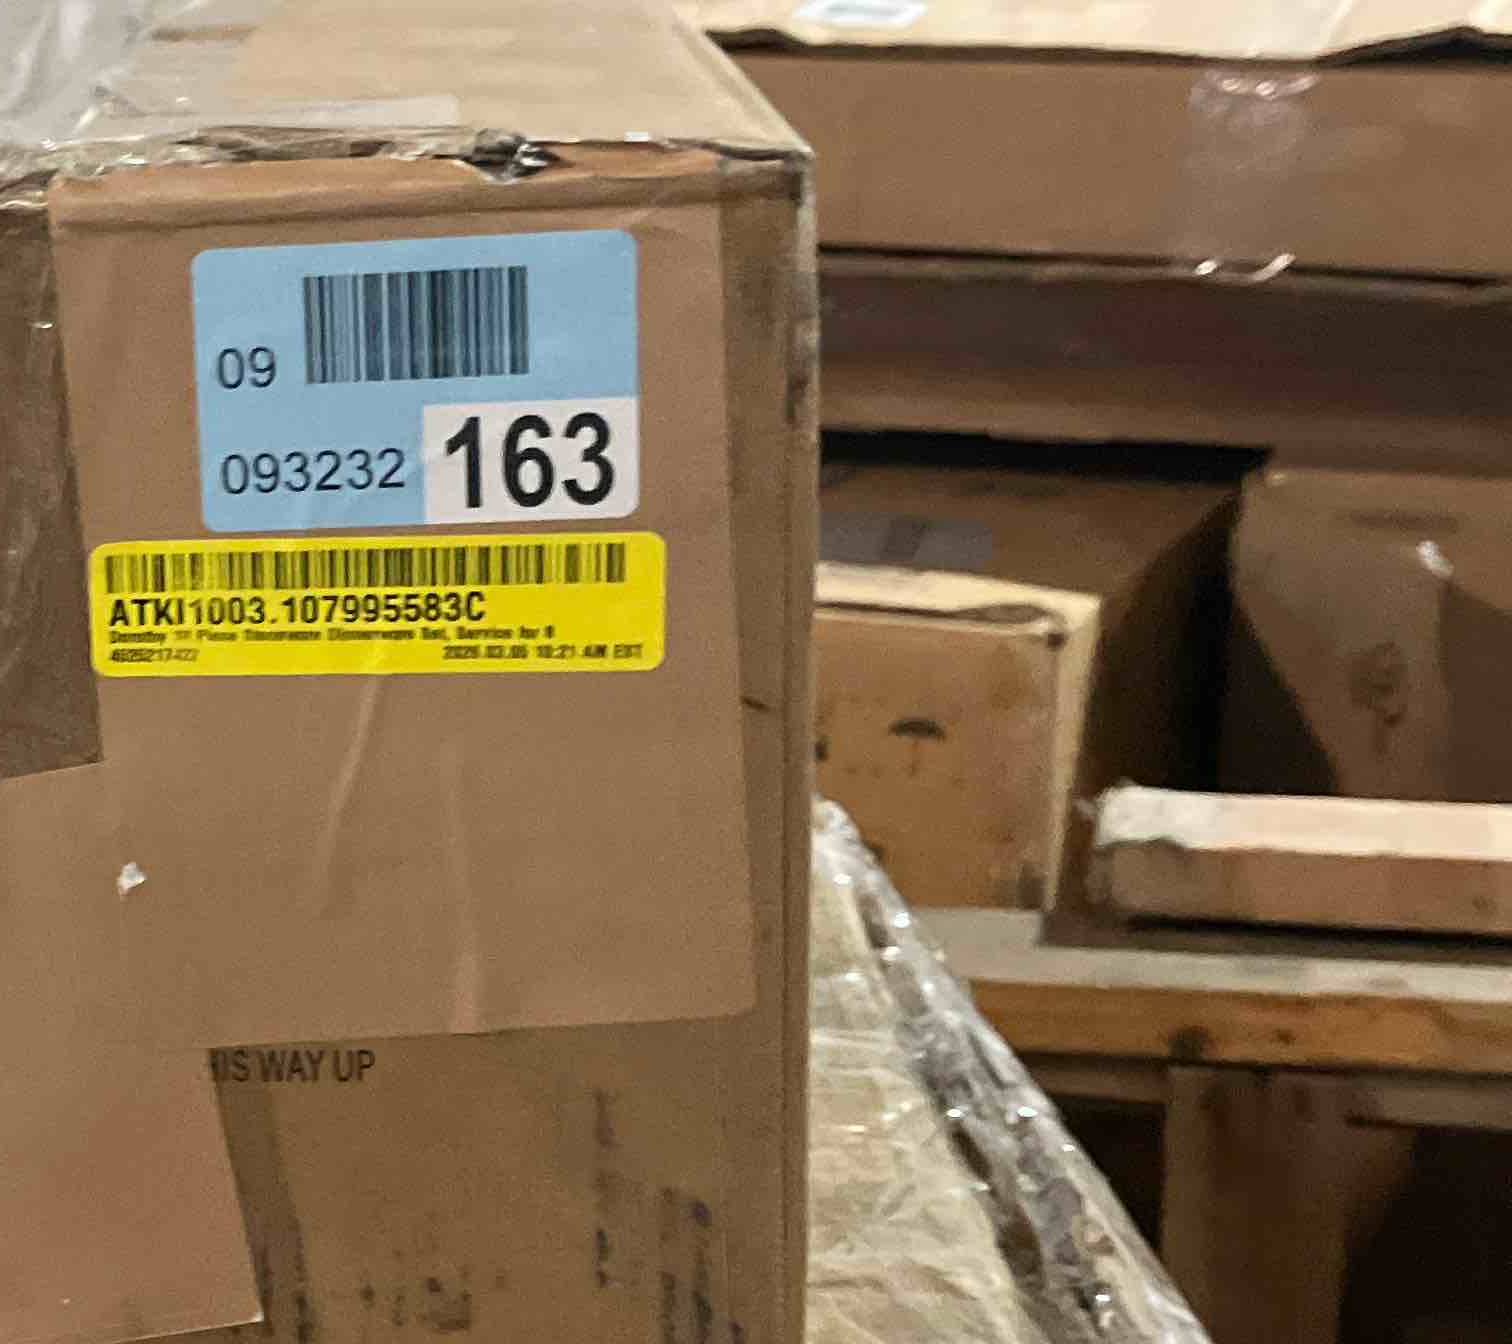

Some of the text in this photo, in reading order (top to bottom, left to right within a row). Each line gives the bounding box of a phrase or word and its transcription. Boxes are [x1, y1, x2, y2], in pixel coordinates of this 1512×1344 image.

[217, 347, 276, 389] 09
[221, 448, 406, 495] 093232
[444, 412, 616, 509] 163
[257, 1049, 326, 1082] WAY
[335, 1048, 376, 1082] UP
